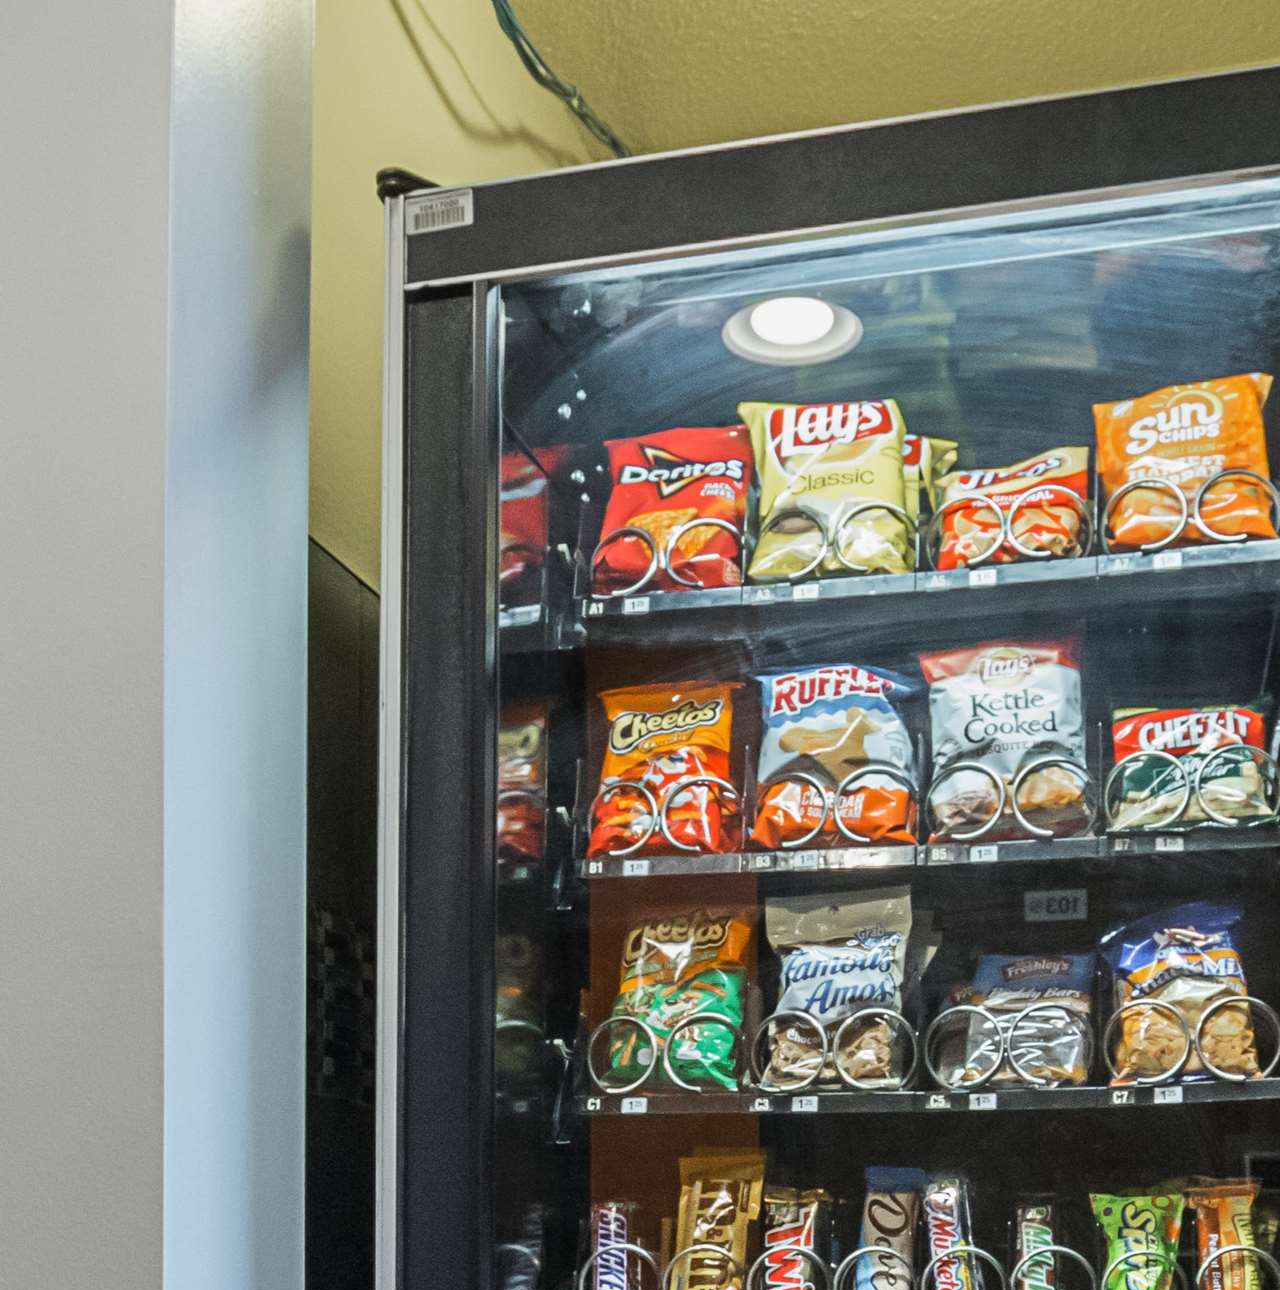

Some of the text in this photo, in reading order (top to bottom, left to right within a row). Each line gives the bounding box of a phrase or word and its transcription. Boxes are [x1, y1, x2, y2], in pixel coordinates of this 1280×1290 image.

[1125, 402, 1222, 455] Sun
[1159, 423, 1220, 443] CHIPS
[620, 460, 744, 484] Doritos
[787, 469, 875, 496] Classic
[970, 690, 1046, 718] Kettle
[610, 700, 722, 752] Cheetos
[964, 711, 1058, 744] Cooked
[783, 949, 893, 992] Famous
[804, 980, 895, 1014] Amos
